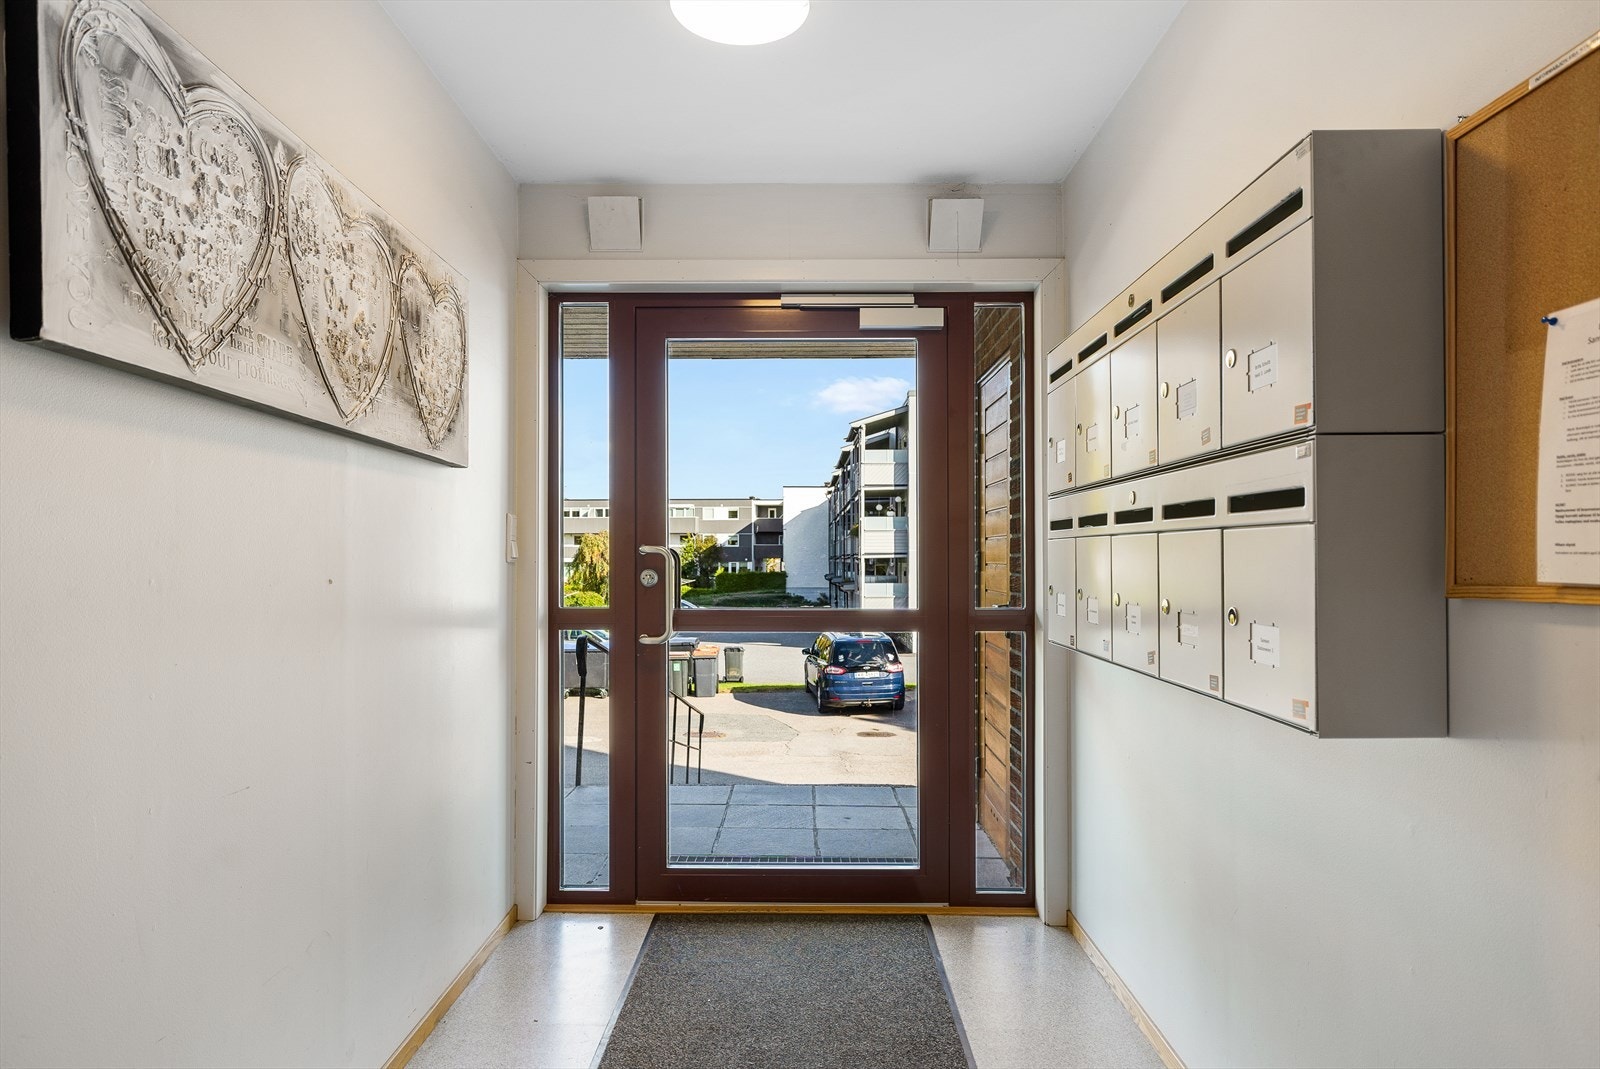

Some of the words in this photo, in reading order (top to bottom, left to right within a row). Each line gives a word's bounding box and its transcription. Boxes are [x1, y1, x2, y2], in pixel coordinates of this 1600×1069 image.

[65, 129, 91, 244] LOVE
[66, 248, 91, 331] YOU
[229, 332, 254, 356] hard
[236, 359, 294, 392] promises
